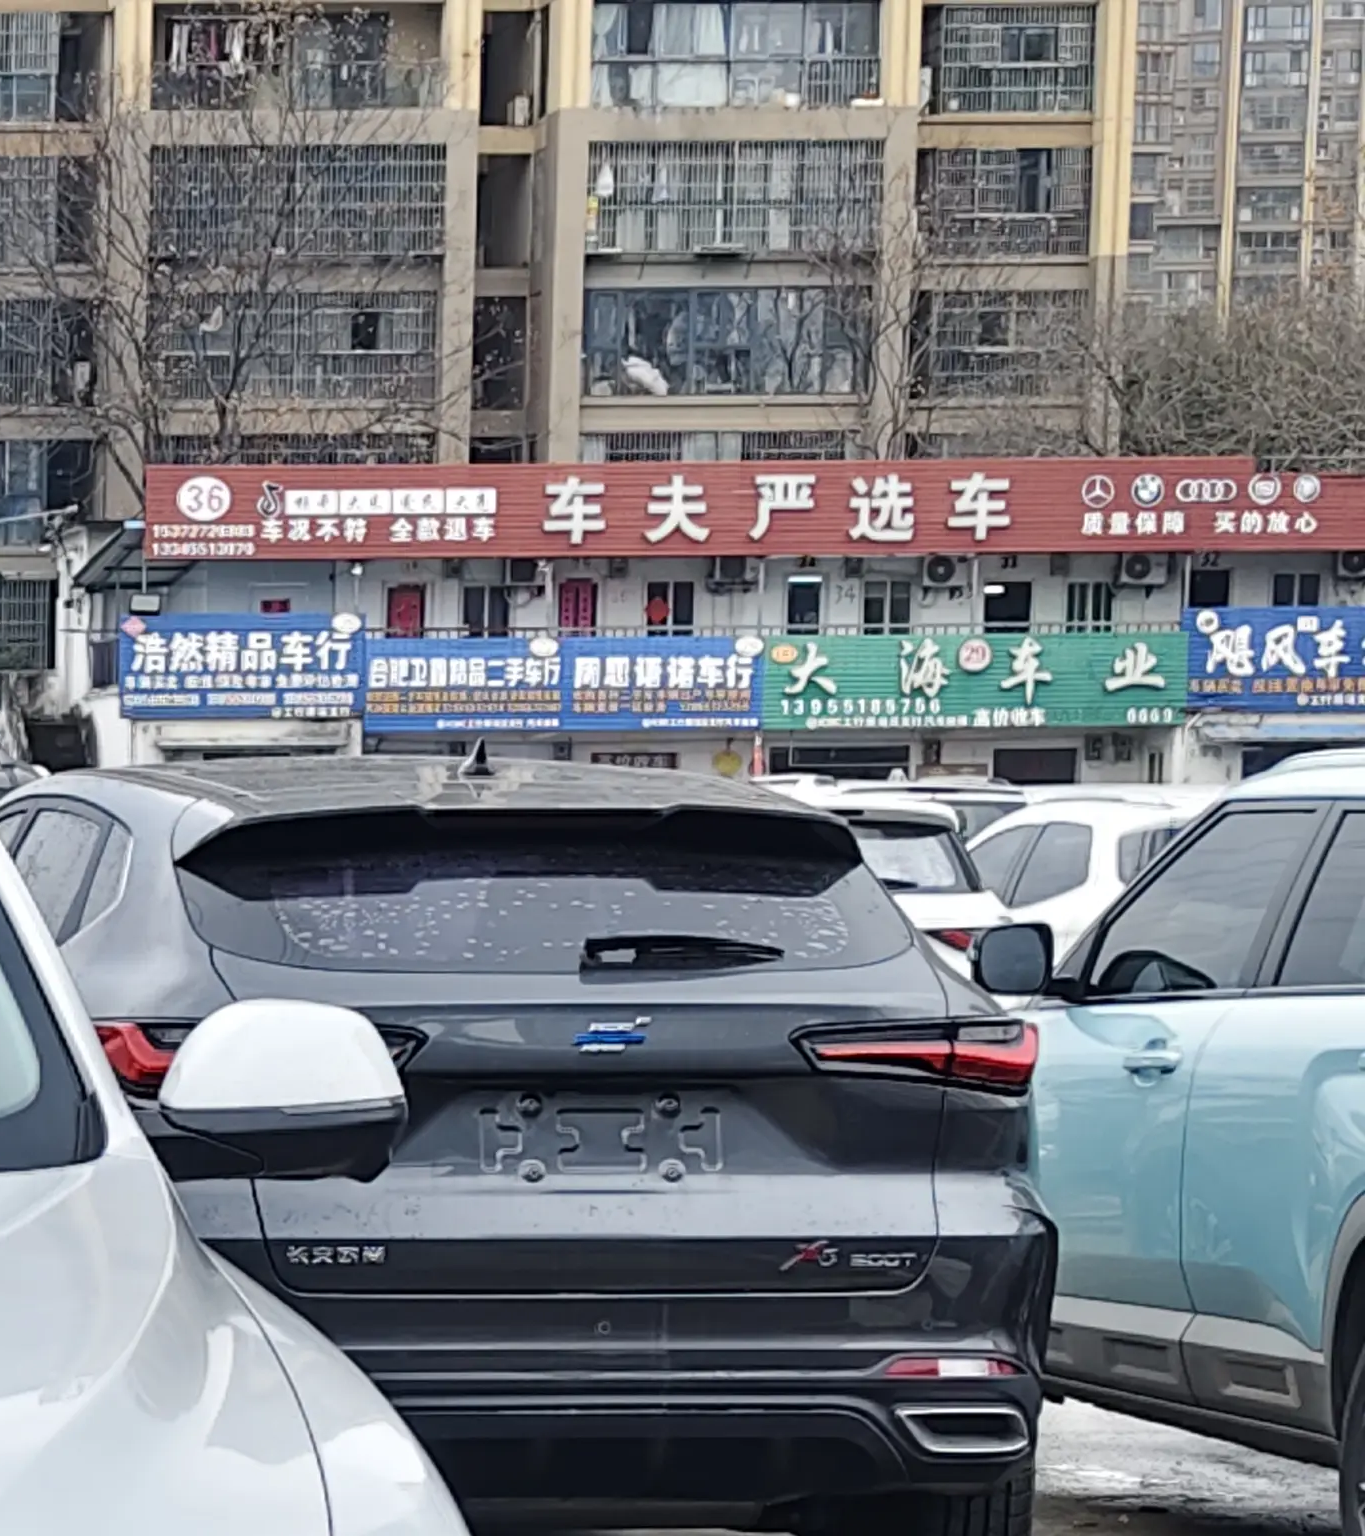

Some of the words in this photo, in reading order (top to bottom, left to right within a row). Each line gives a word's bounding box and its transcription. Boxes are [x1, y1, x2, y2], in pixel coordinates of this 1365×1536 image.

[186, 485, 225, 512] 36
[542, 473, 1011, 545] 车夫严选车
[260, 518, 368, 543] 车况不符
[389, 518, 495, 543] 全款退车
[1081, 510, 1185, 535] 质量保障
[1213, 510, 1318, 535] 买的放心
[131, 631, 351, 674] 浩然精品车行
[783, 636, 1166, 705] 大海车业
[972, 707, 1046, 727] 高价收车
